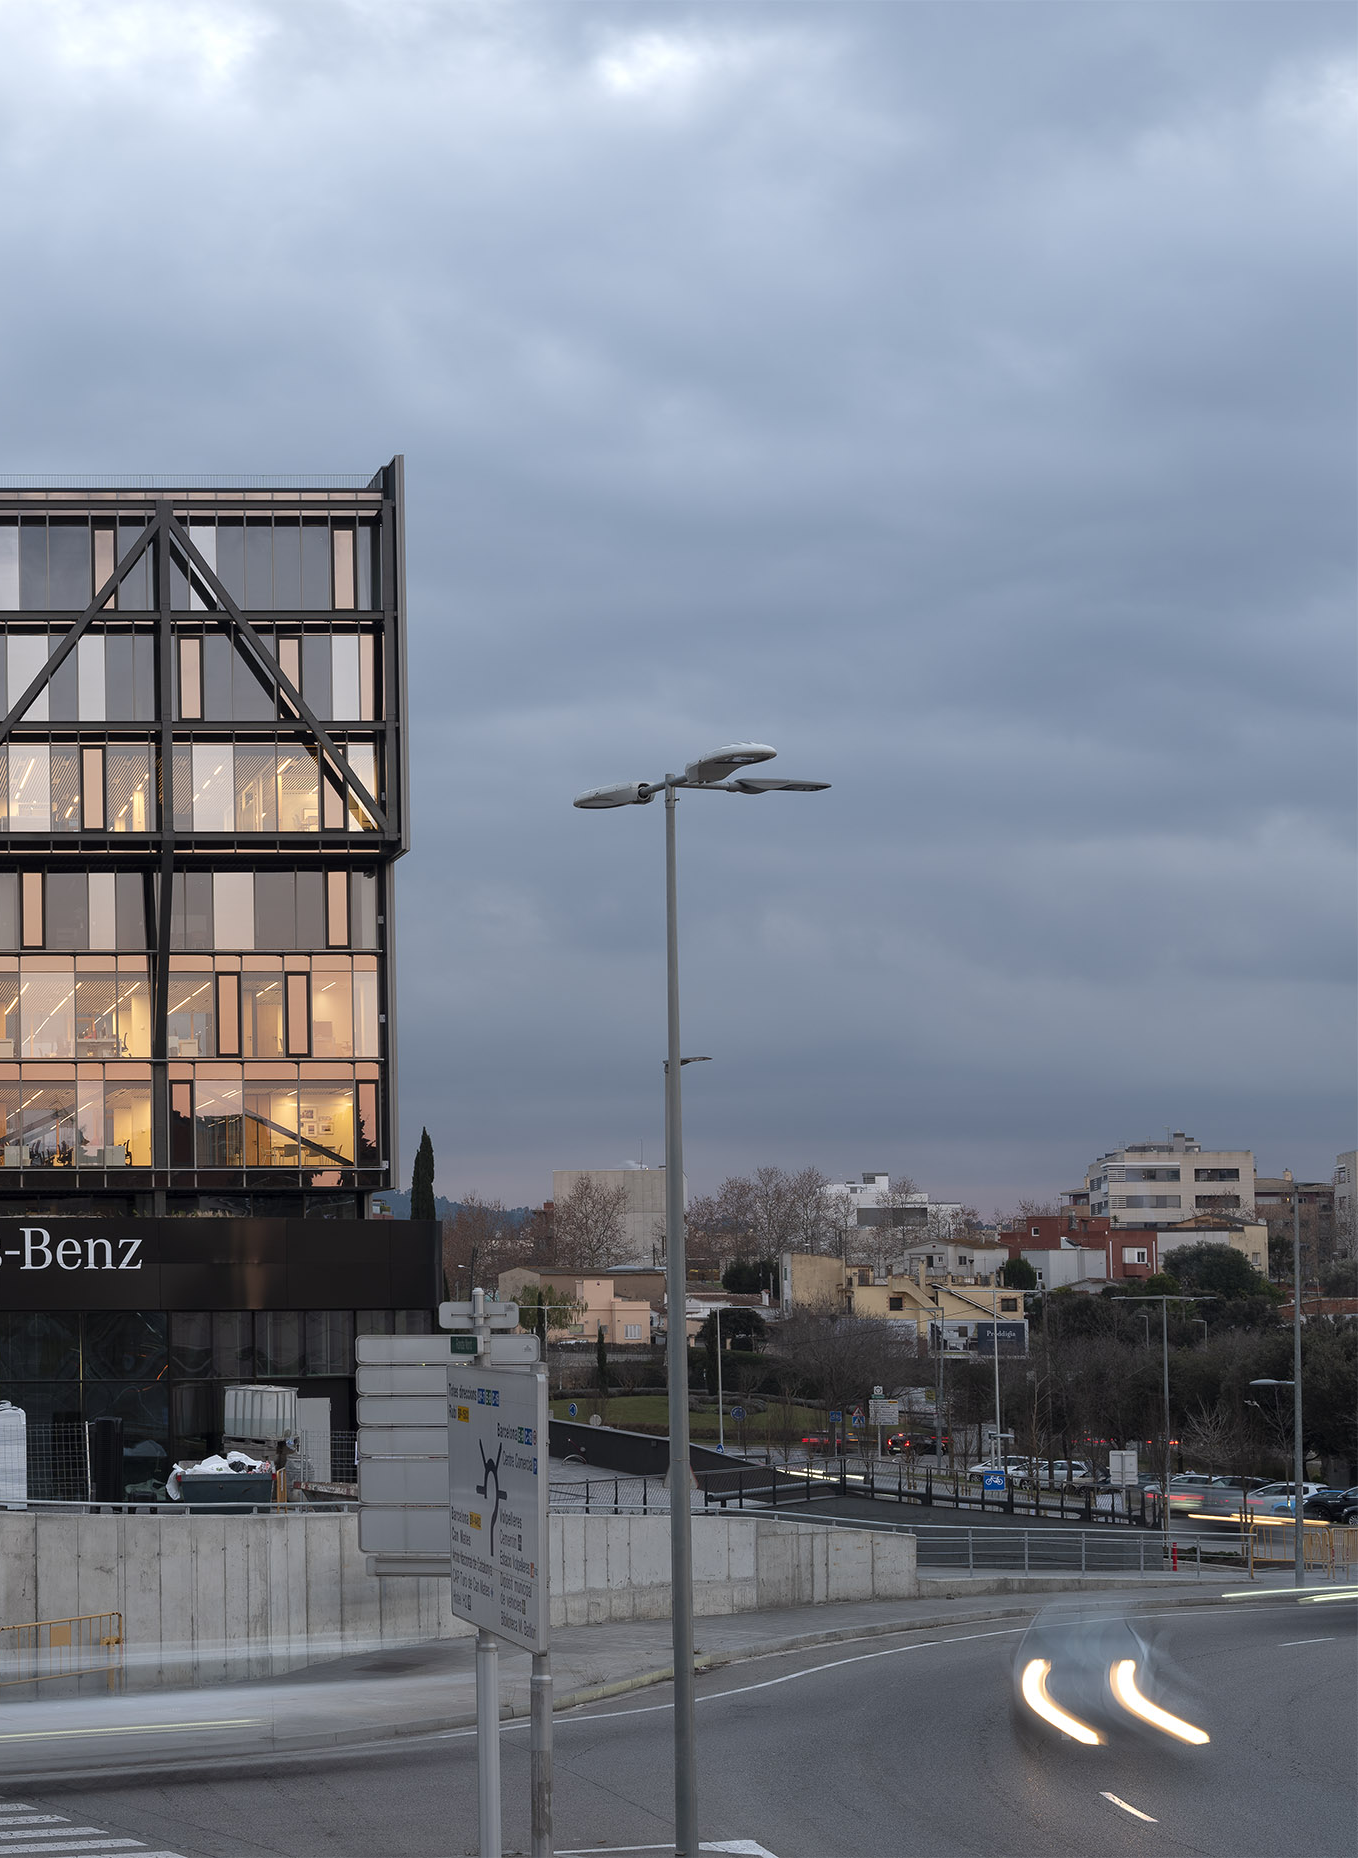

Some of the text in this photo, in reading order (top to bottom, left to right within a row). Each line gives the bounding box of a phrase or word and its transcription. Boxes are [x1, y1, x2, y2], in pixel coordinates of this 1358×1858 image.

[986, 1330, 1016, 1339] Prddigia
[498, 1422, 517, 1441] Barcelona
[451, 1506, 468, 1525] Barcelona
